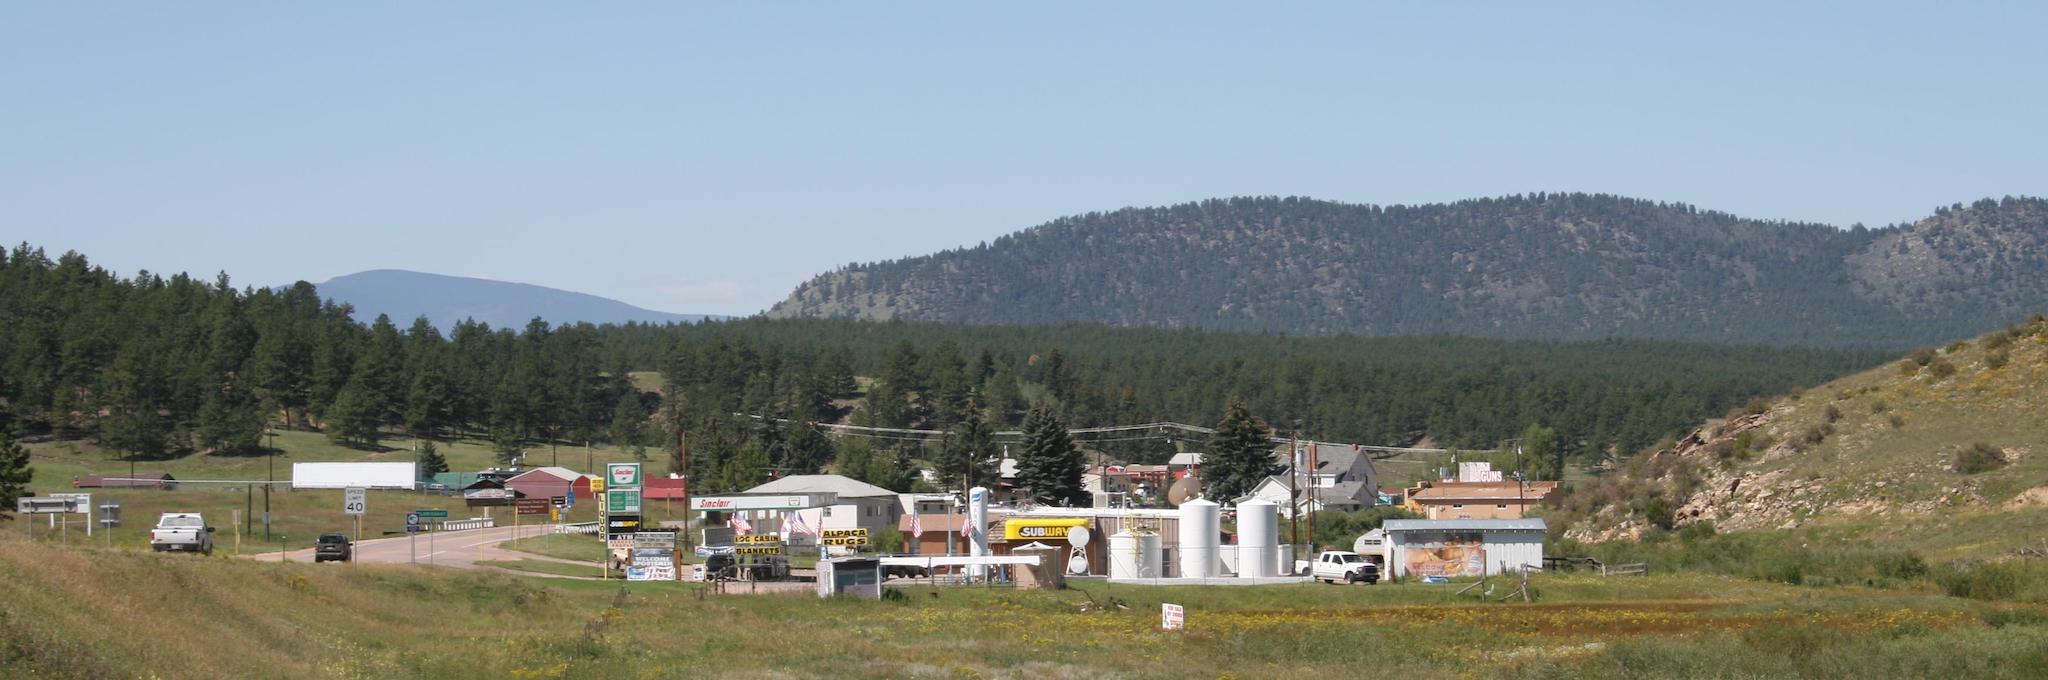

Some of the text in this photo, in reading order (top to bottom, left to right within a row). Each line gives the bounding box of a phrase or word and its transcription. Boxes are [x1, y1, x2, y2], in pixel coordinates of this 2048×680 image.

[1481, 471, 1502, 482] GUNS
[347, 502, 363, 511] 40
[700, 499, 730, 508] Sinclair
